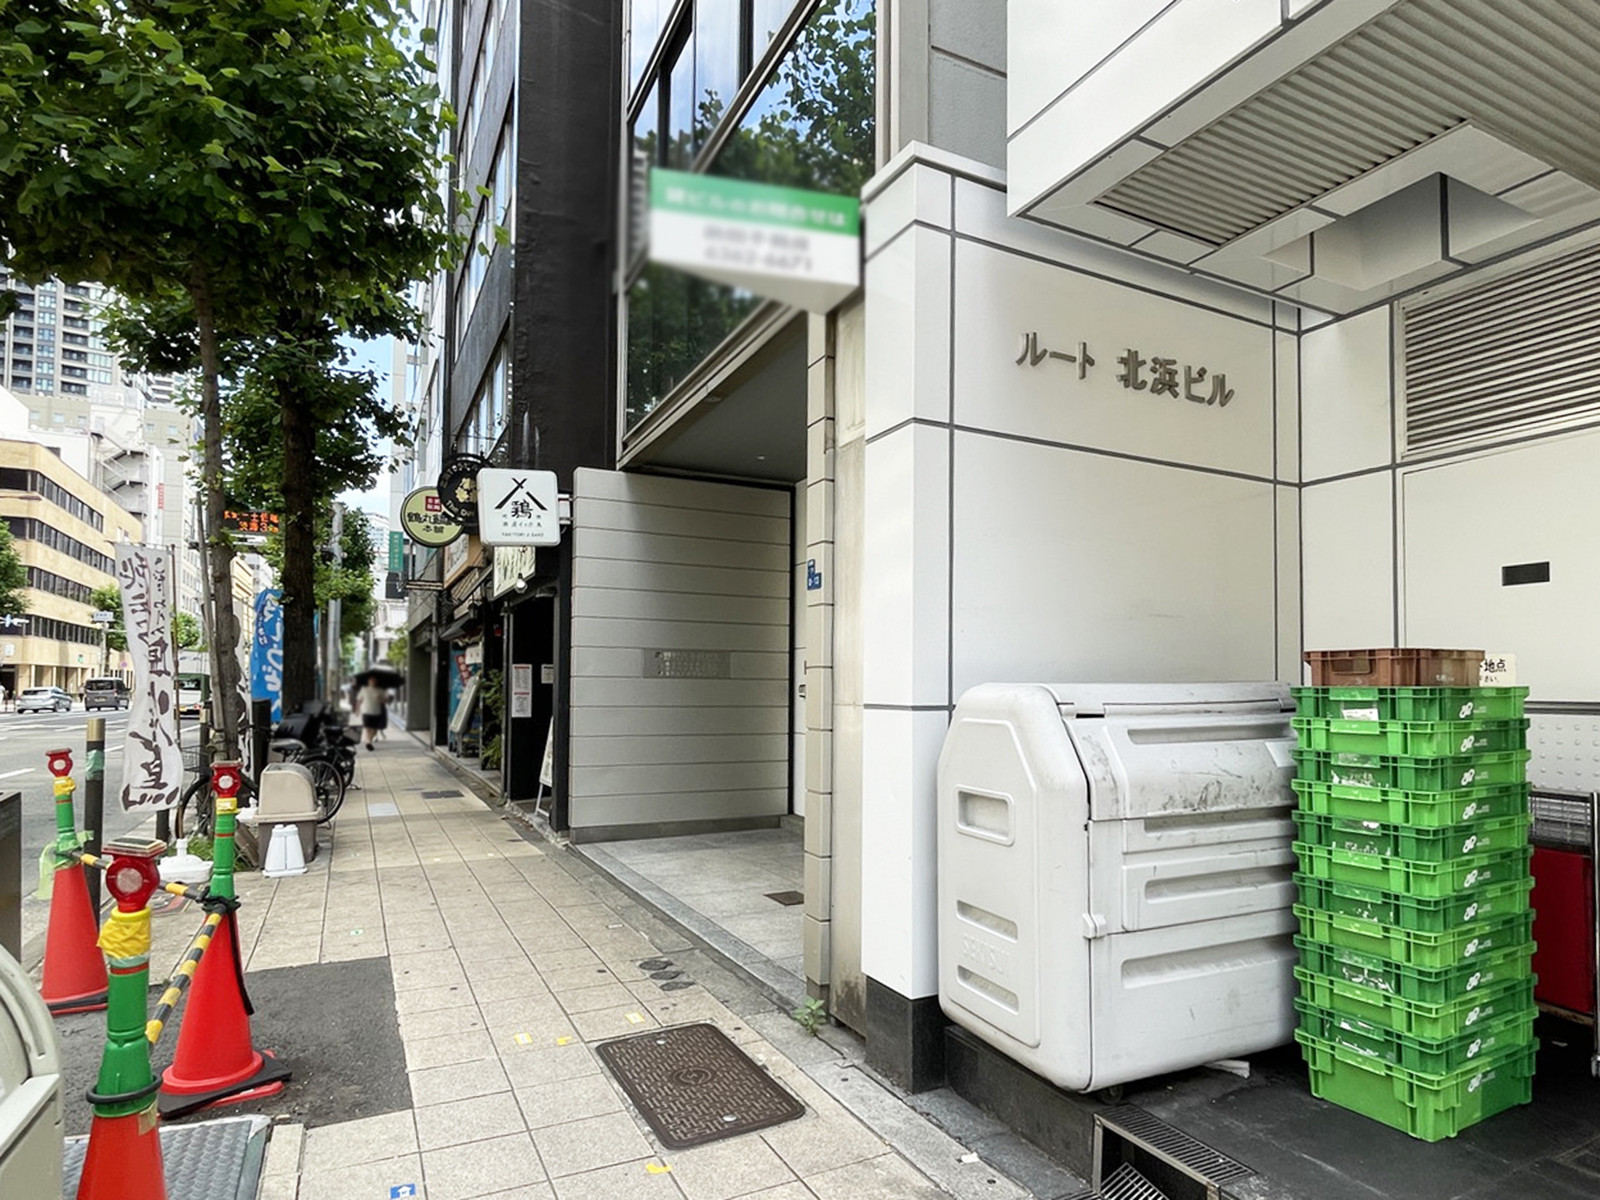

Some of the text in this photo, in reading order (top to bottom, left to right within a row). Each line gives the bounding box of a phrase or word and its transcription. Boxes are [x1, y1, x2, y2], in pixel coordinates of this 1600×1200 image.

[1015, 331, 1235, 407] ルート 北浜ビル
[1480, 659, 1507, 673] 地点
